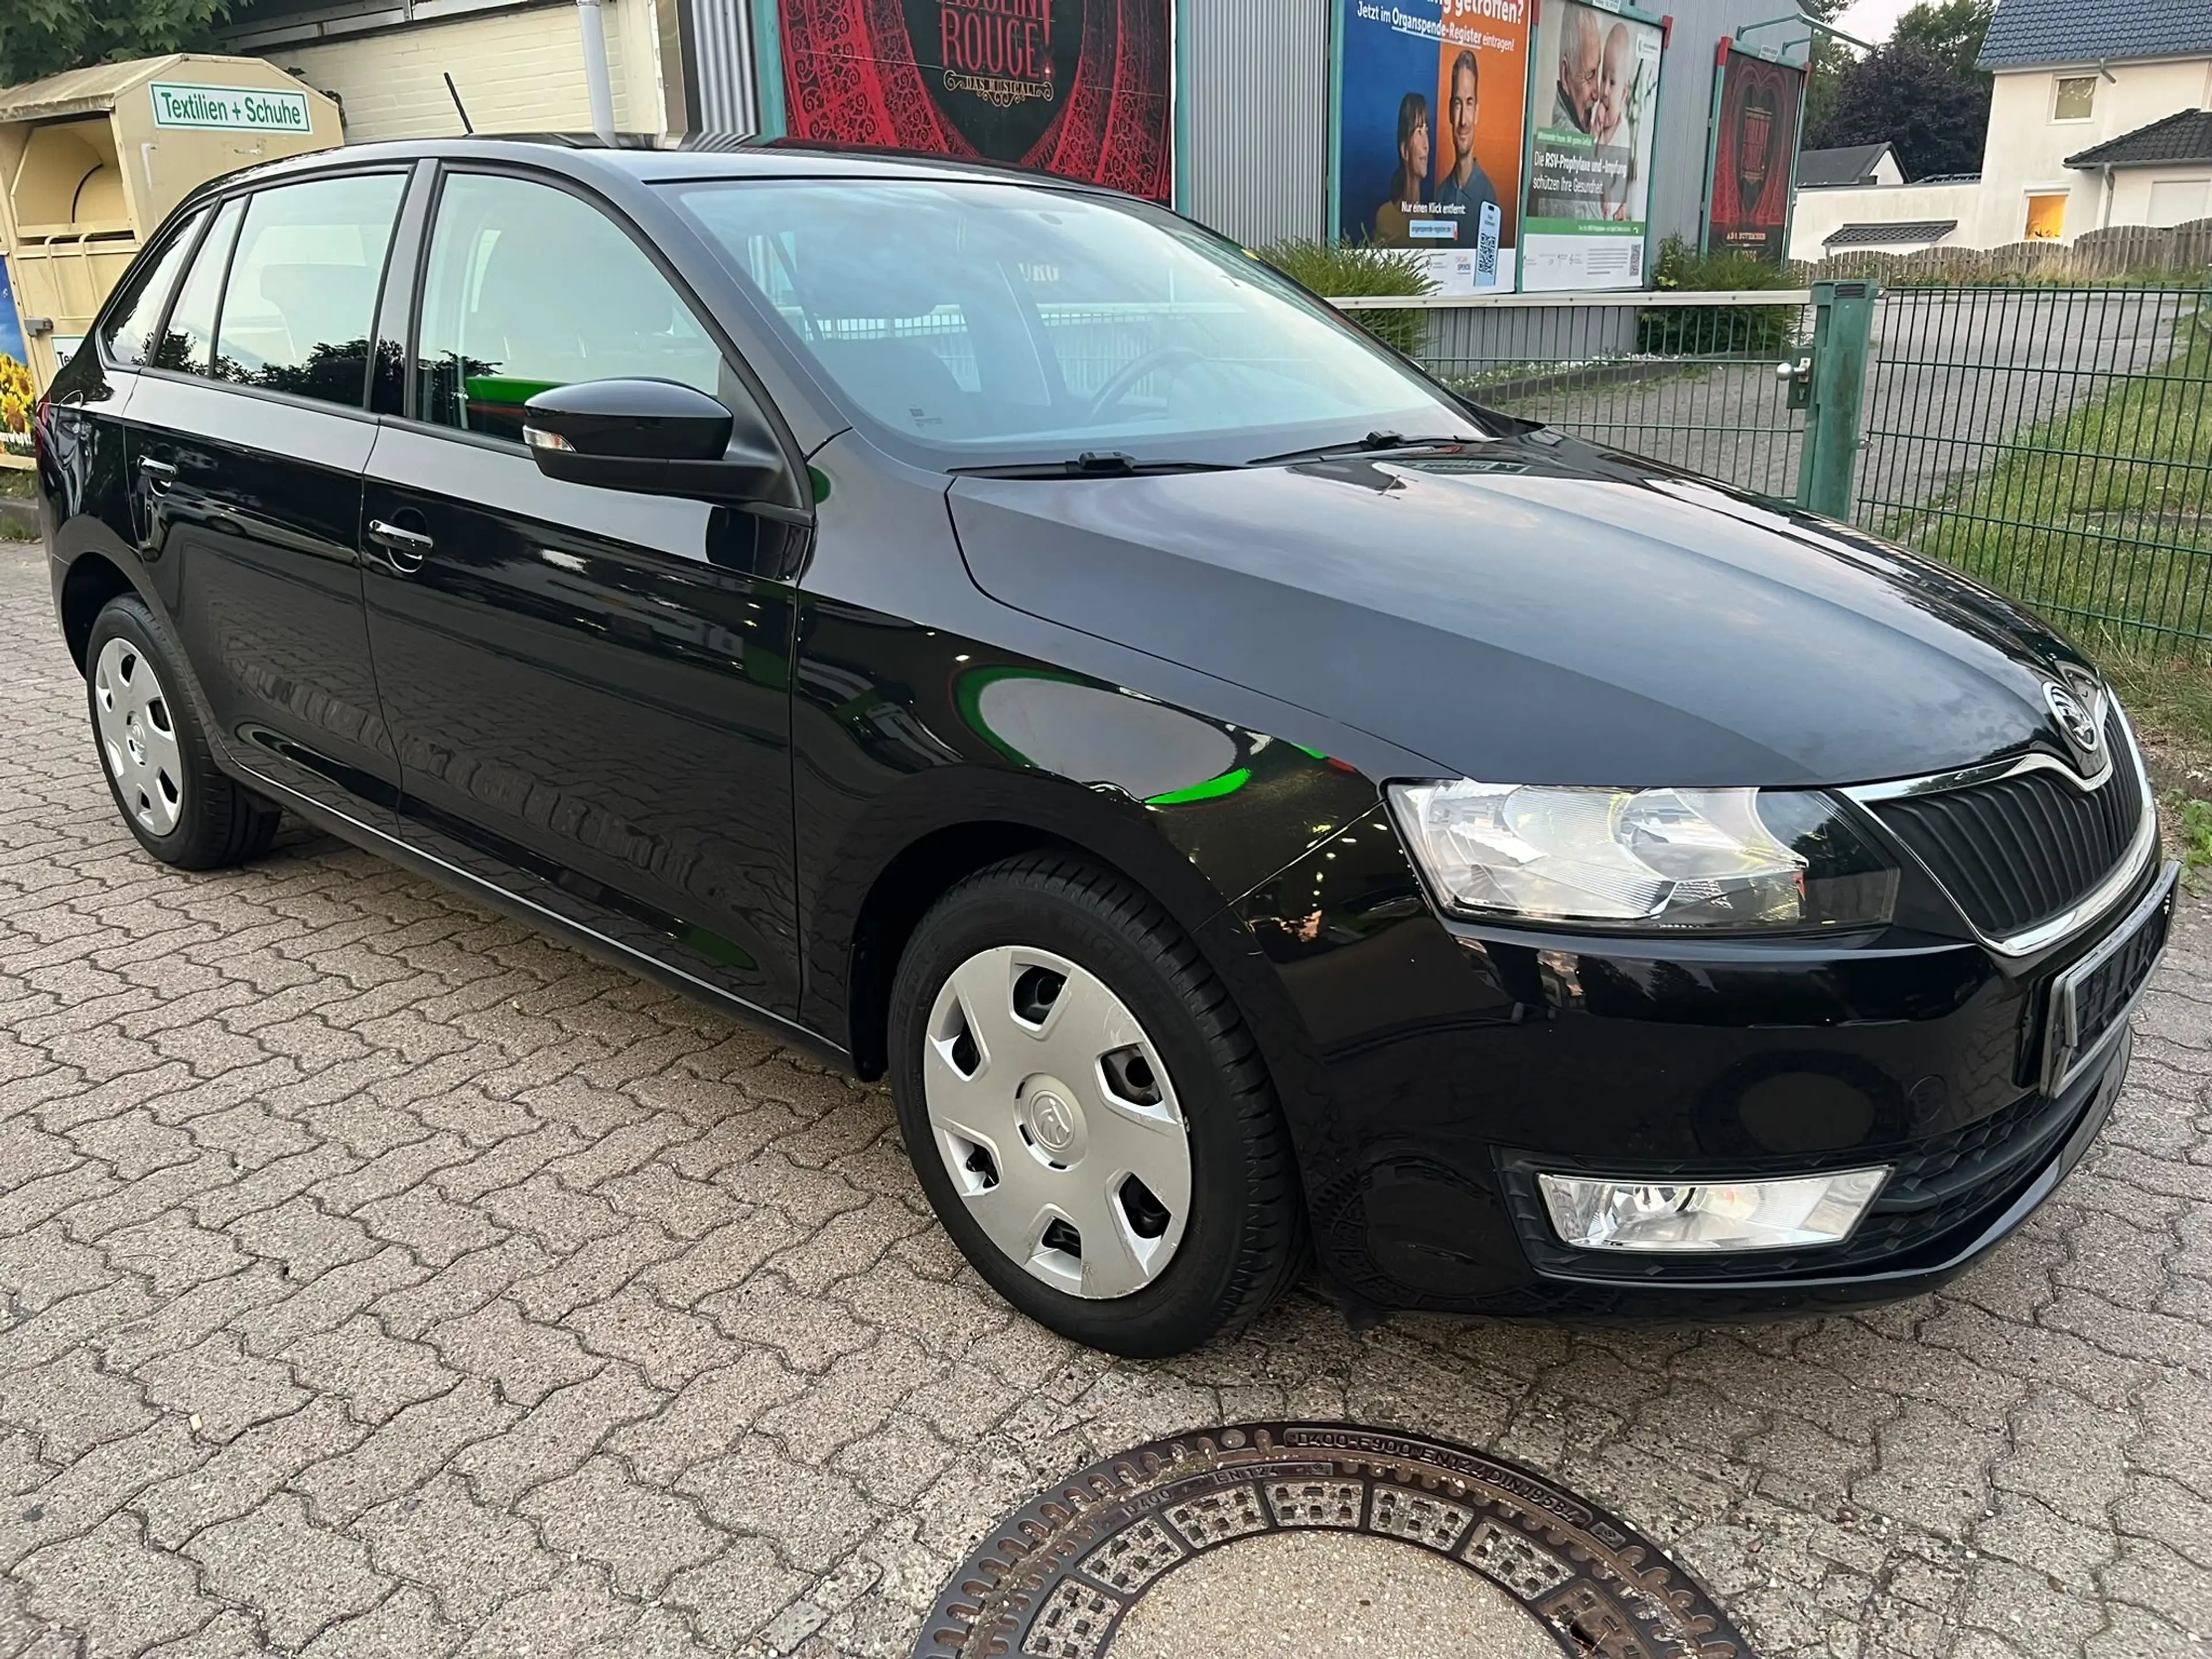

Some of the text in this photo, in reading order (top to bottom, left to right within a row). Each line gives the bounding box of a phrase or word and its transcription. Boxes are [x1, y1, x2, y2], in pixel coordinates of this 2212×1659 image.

[1357, 1, 1380, 21] Jetzt
[1380, 7, 1391, 24] im
[1392, 7, 1482, 44] Organspende-Register
[1482, 32, 1515, 53] eintragen!
[966, 75, 984, 90] DAS
[161, 92, 301, 124] Textilien + Schuhe
[1535, 150, 1544, 167] Die
[1545, 151, 1590, 174] RSV-Prophylaxe
[1591, 158, 1602, 172] und
[1533, 174, 1559, 191] schützen
[1560, 176, 1572, 192] Ihre
[1401, 200, 1412, 213] Nur
[1413, 202, 1427, 213] einen
[1429, 202, 1442, 214] Klick
